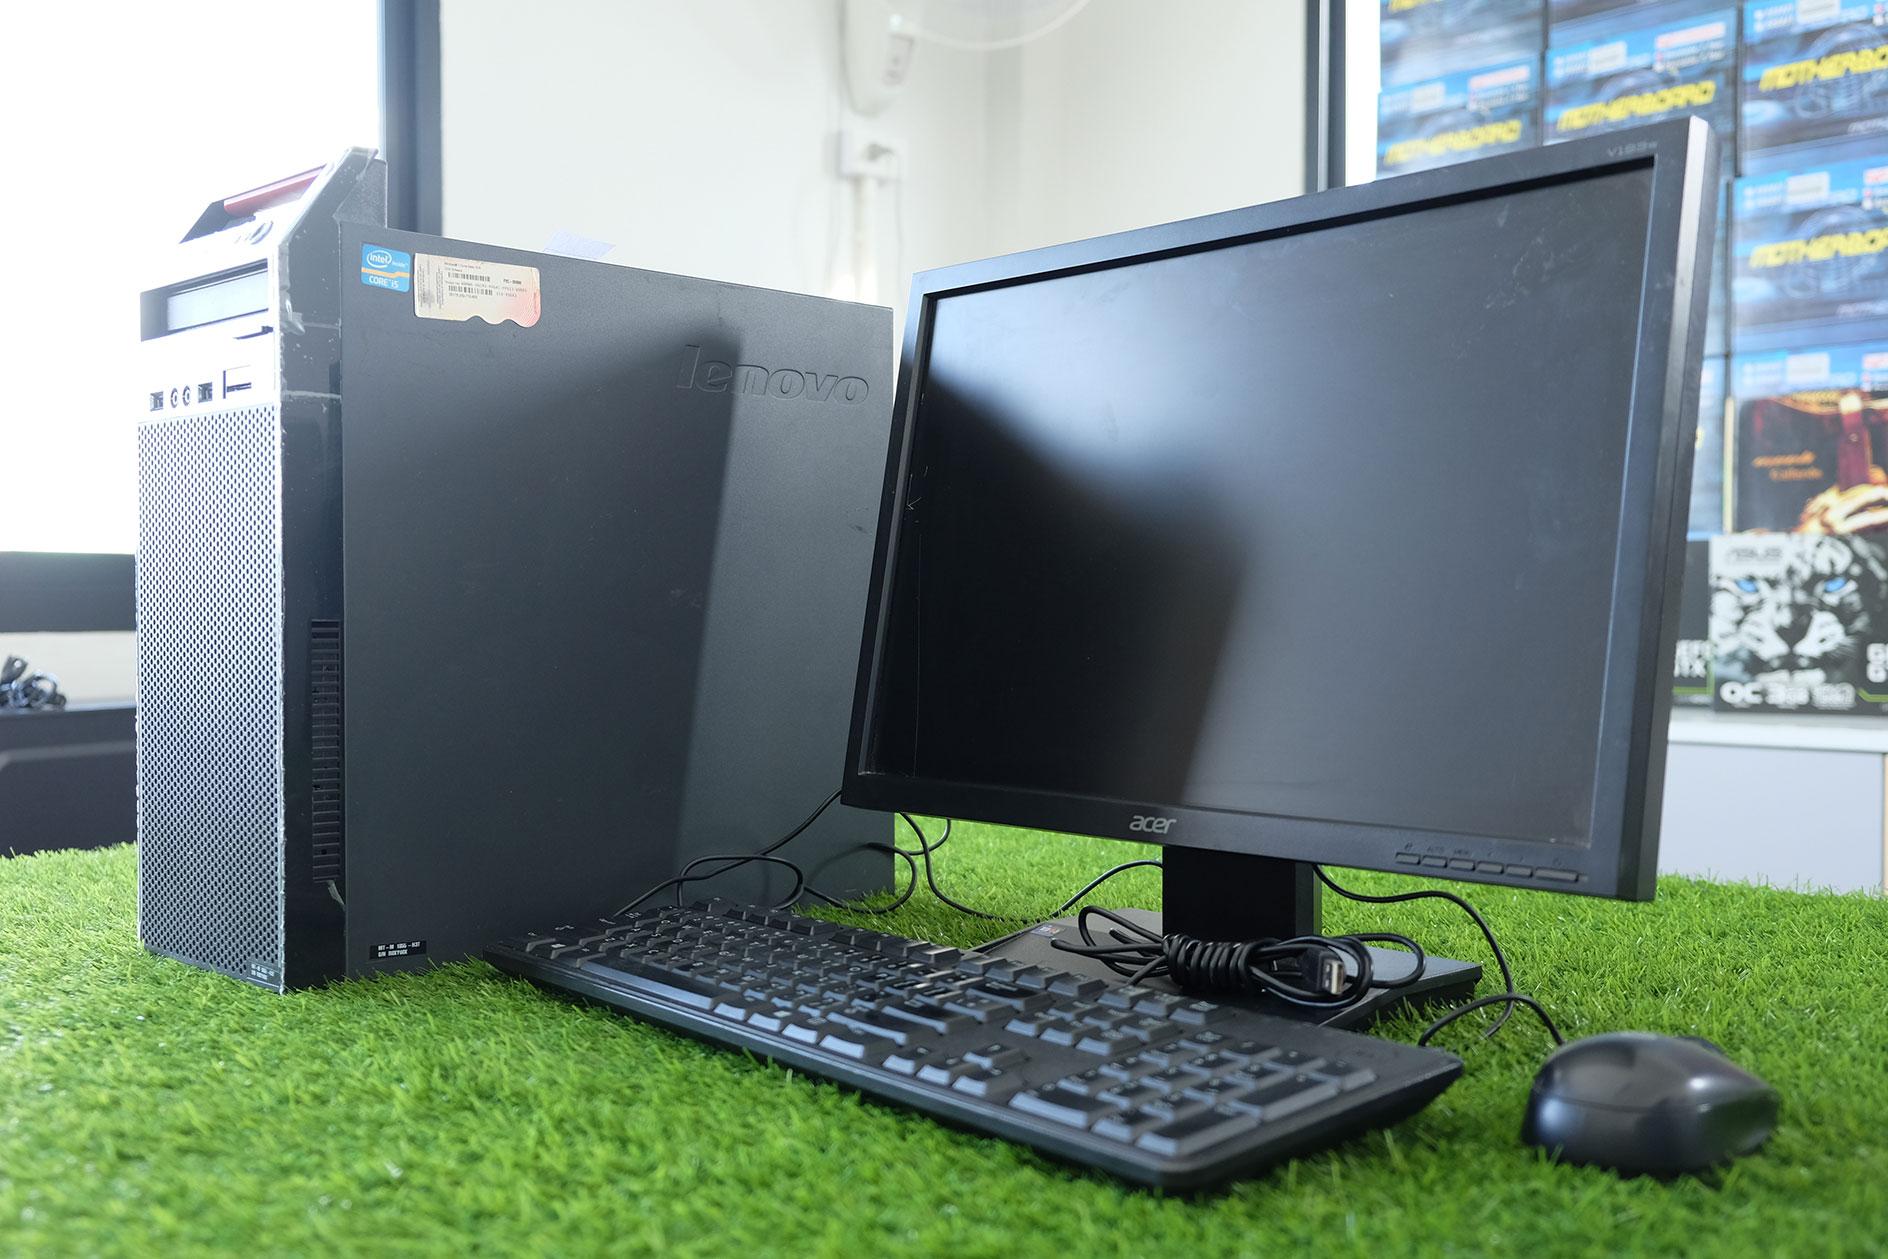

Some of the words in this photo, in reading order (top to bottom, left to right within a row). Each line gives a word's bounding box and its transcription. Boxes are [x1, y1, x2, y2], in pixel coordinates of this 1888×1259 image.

[369, 252, 389, 264] intel
[676, 344, 870, 405] lenovo
[1129, 815, 1177, 834] acer
